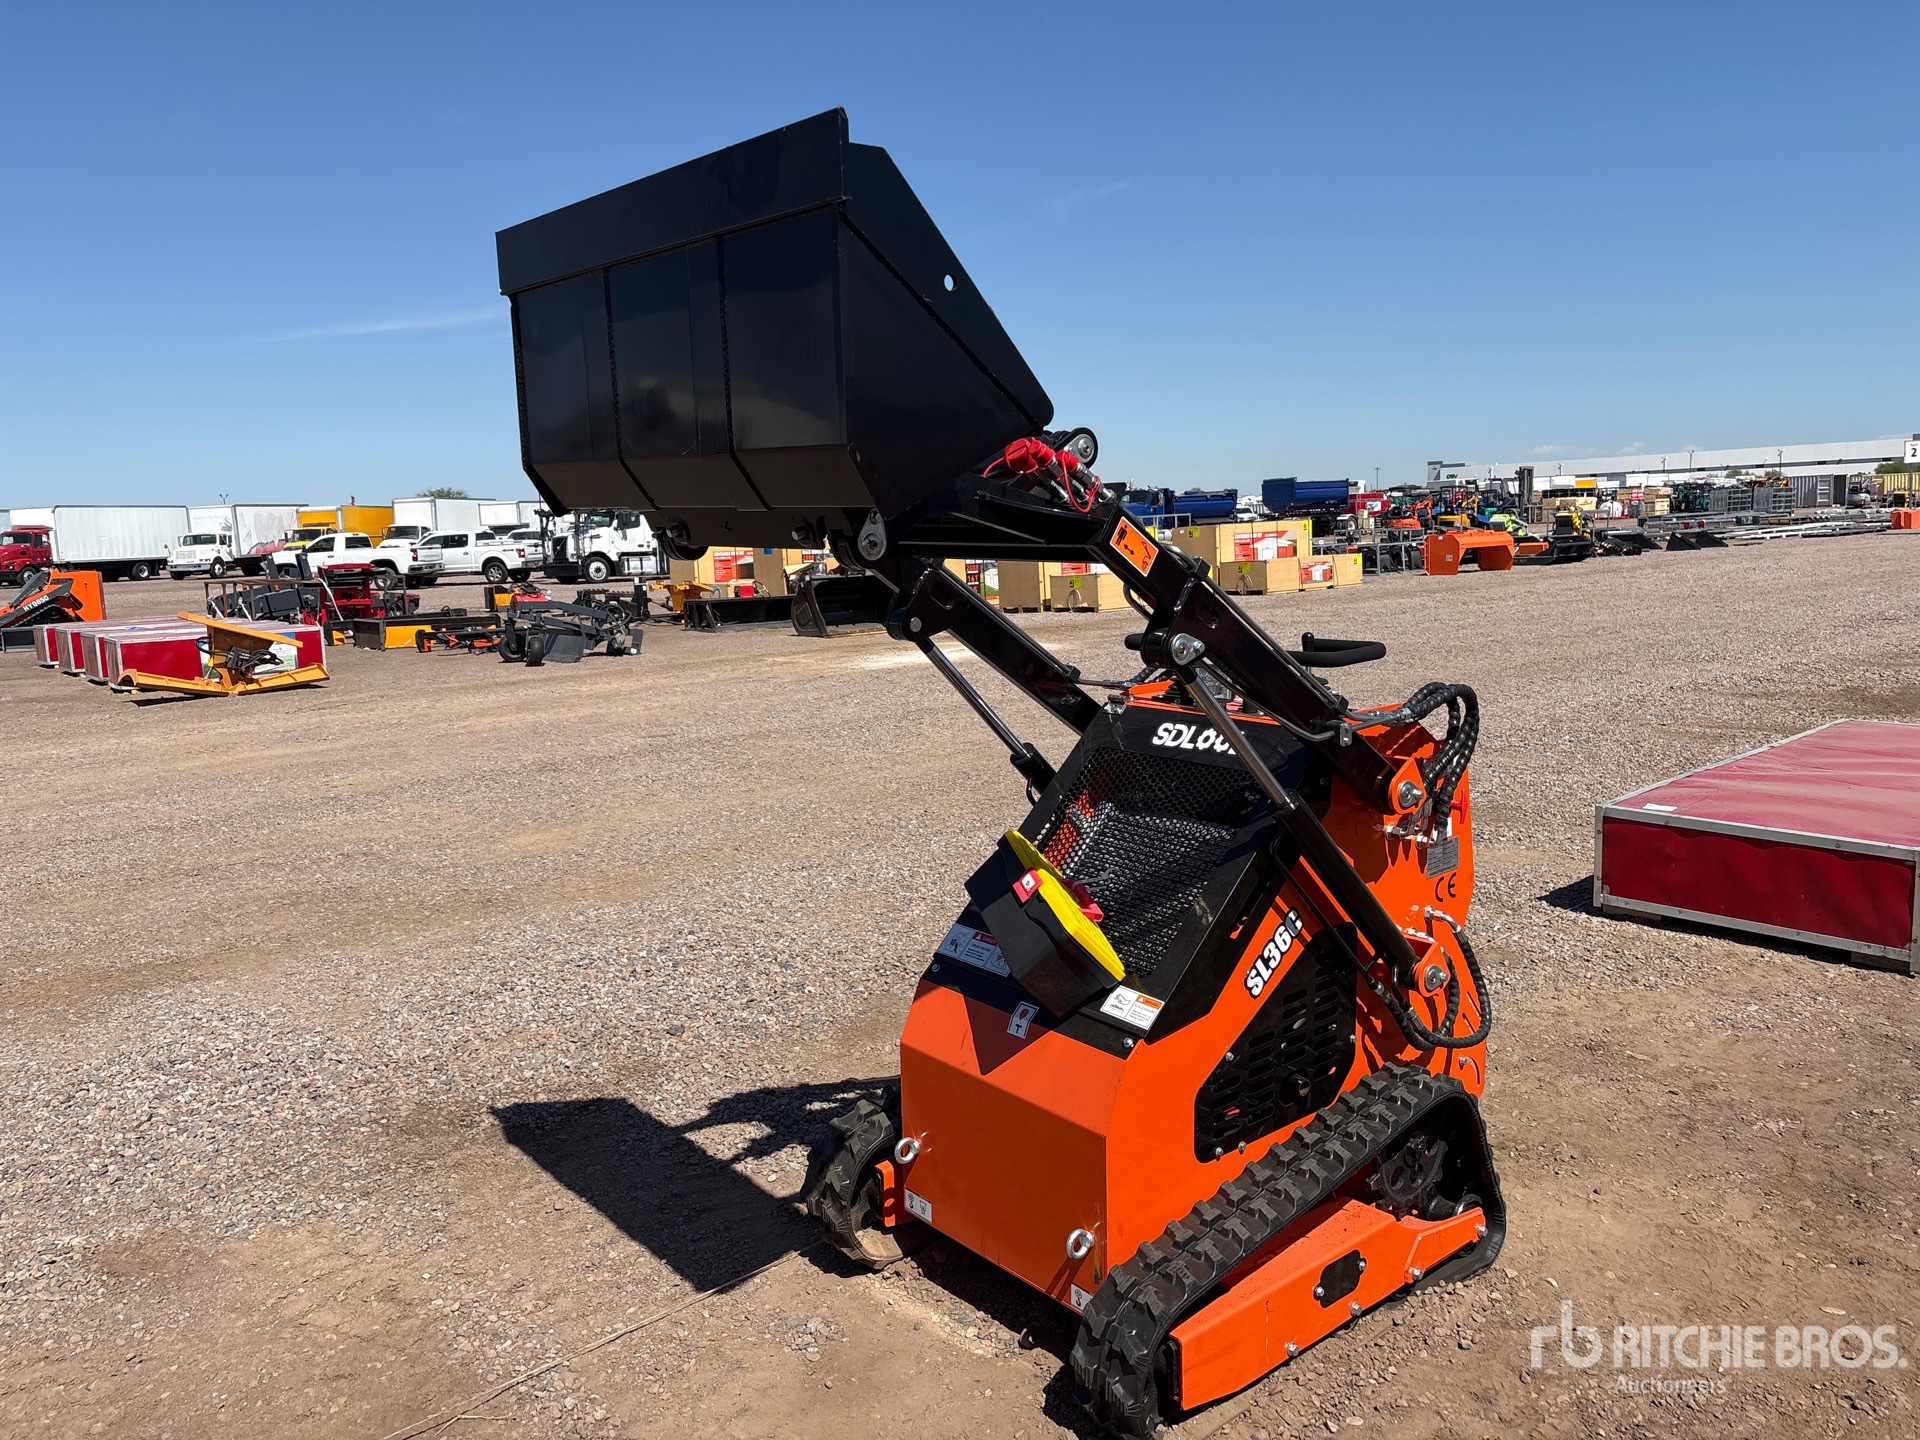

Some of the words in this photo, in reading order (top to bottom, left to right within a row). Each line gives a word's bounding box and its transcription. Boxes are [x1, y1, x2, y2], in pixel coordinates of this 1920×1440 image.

[1152, 722, 1245, 755] SDLOO
[1435, 871, 1457, 903] CE
[1246, 909, 1303, 996] SL36C
